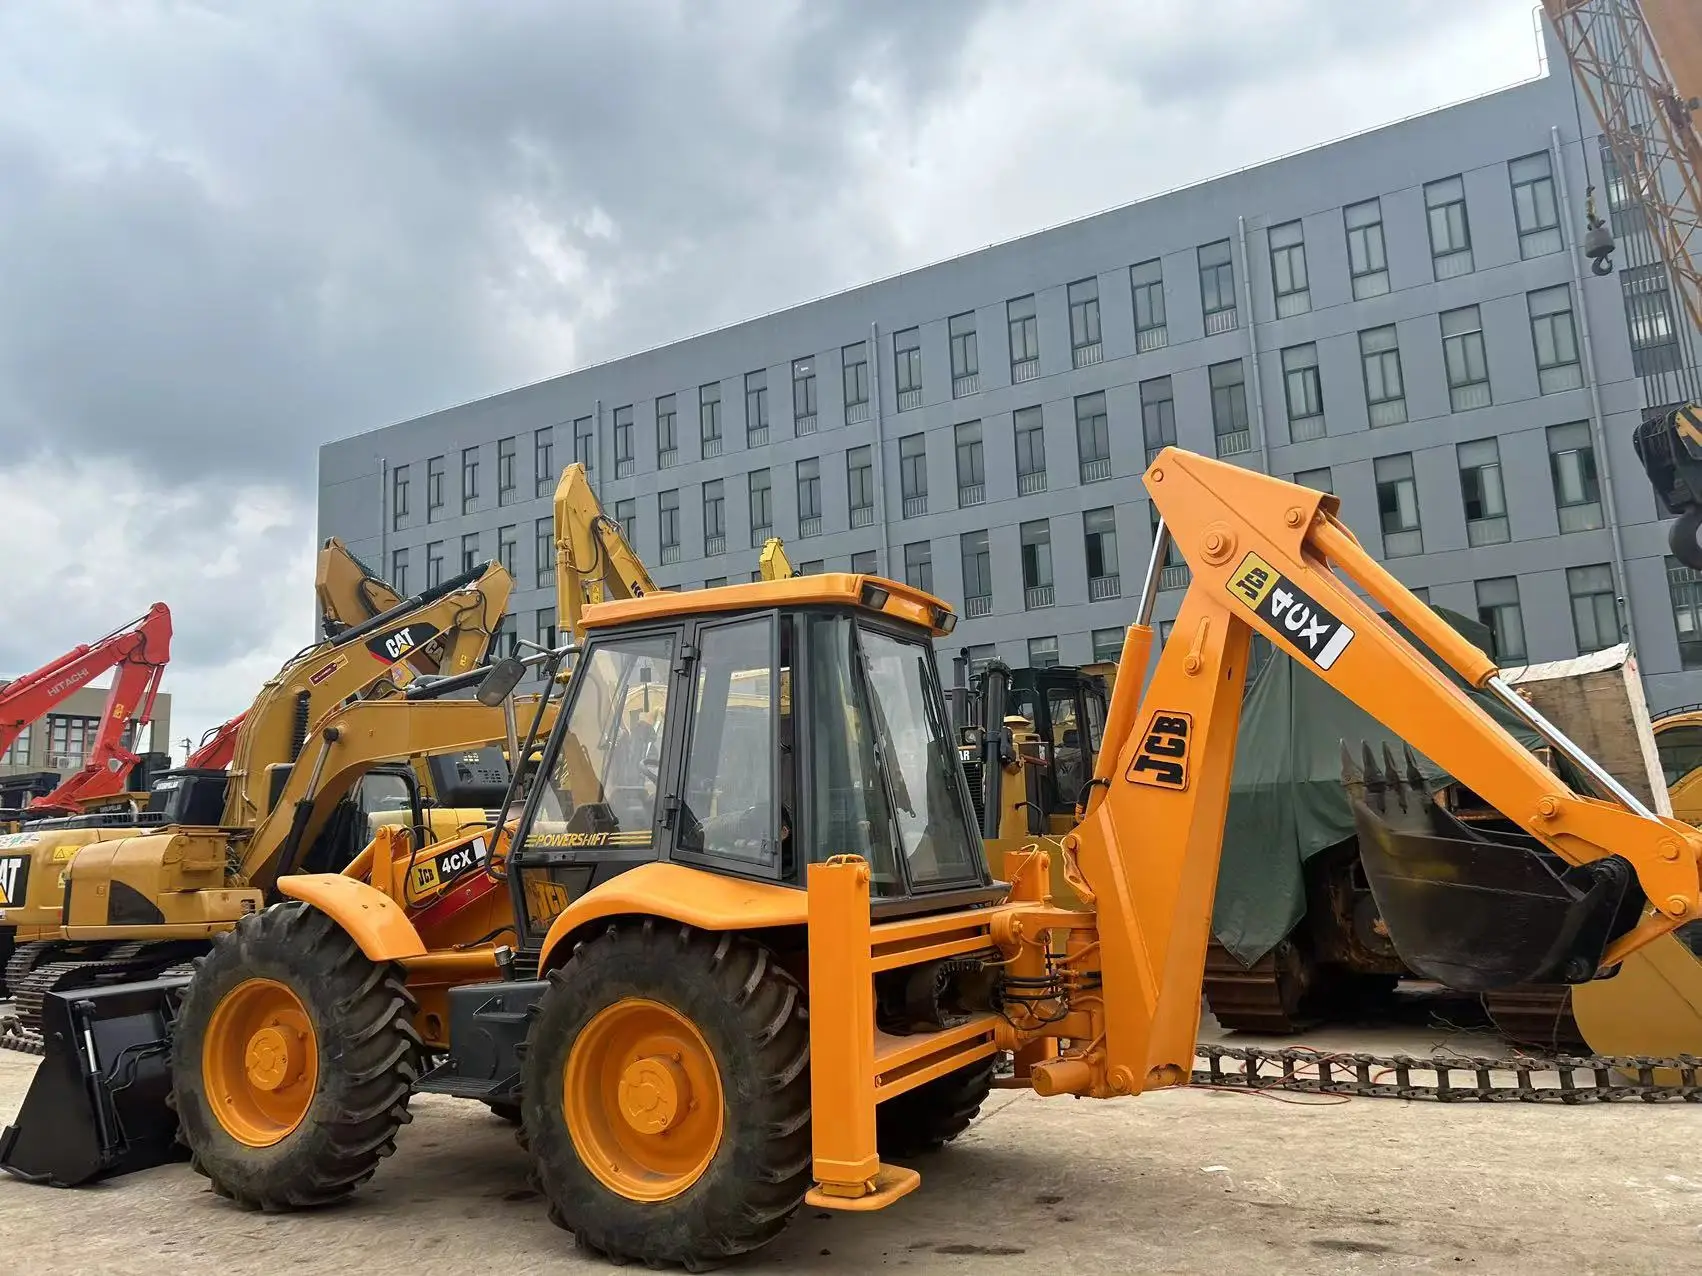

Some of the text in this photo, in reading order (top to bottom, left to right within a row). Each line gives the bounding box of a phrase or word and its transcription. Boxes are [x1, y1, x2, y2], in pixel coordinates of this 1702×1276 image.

[1236, 567, 1331, 650] JCB 4CX
[385, 627, 415, 658] CAT
[47, 667, 90, 697] HITACHI
[1133, 715, 1188, 785] JCB
[536, 832, 609, 847] POWERSHIFT
[0, 858, 22, 904] AT
[417, 848, 472, 886] JCB 4CX
